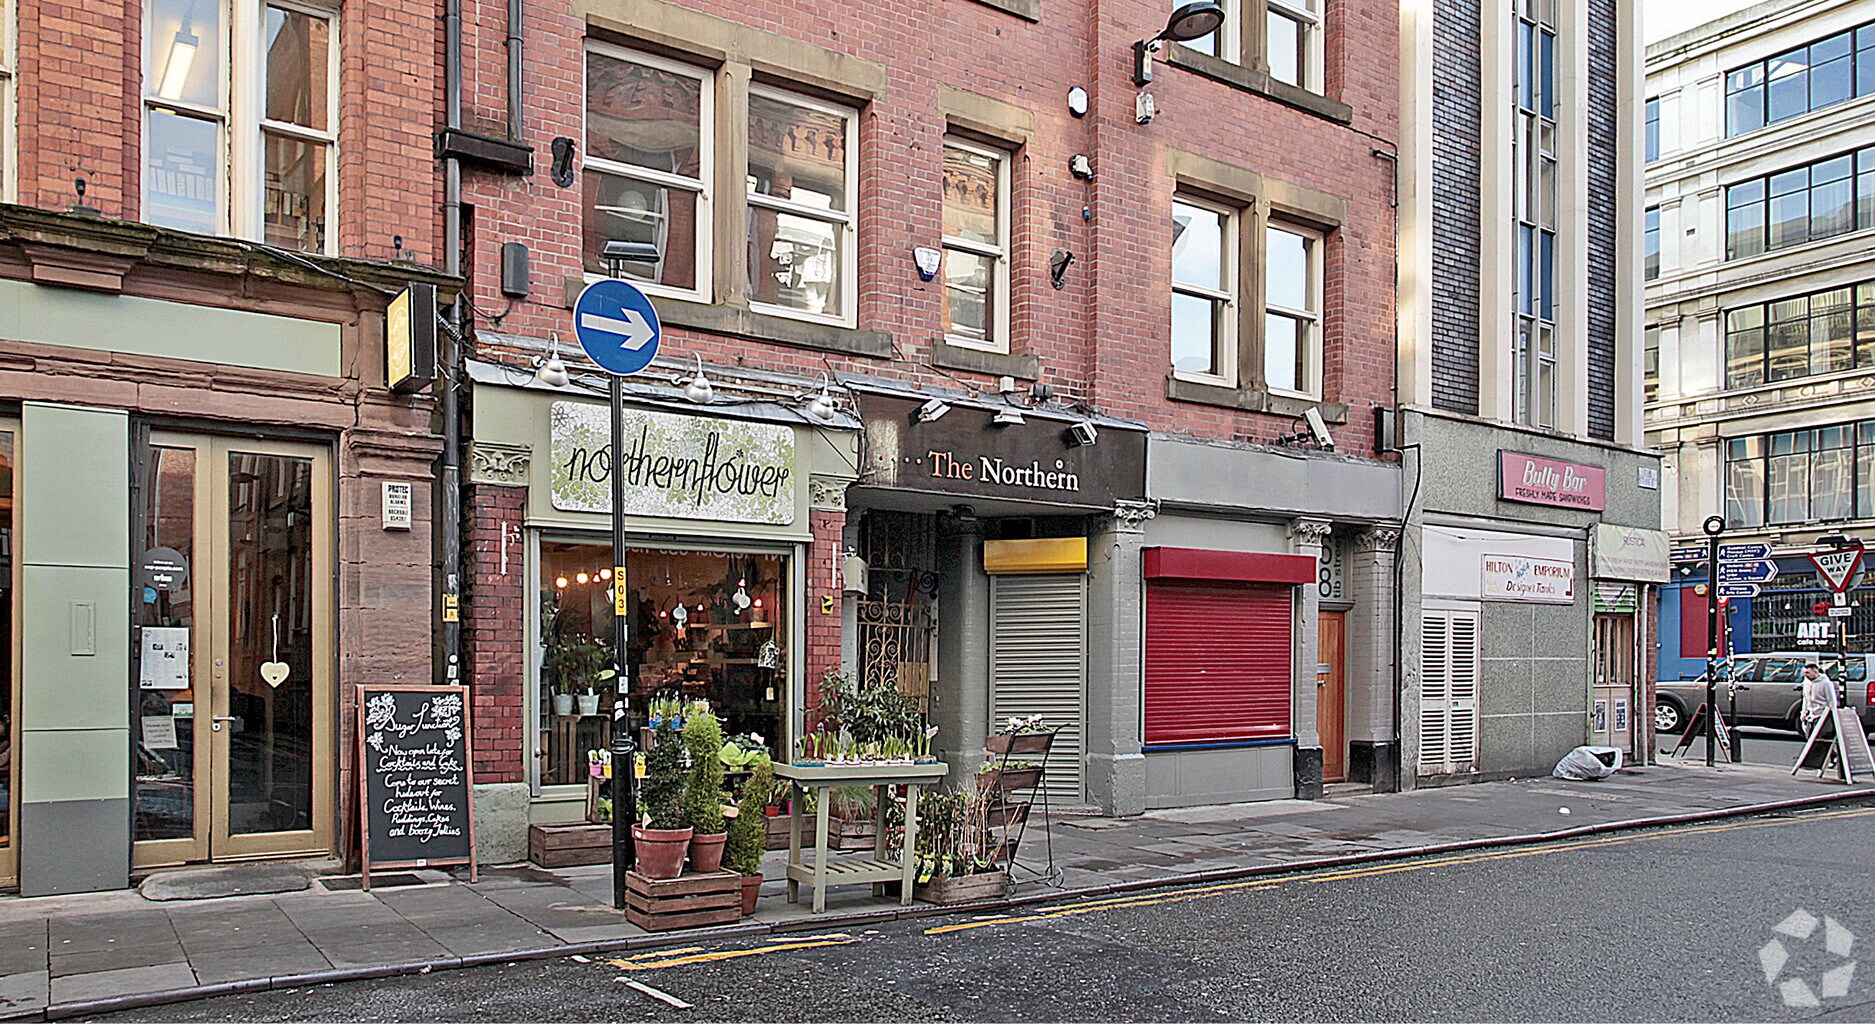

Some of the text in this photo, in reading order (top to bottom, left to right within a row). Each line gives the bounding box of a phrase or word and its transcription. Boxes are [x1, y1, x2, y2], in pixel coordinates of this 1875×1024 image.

[928, 450, 1080, 491] The Northern
[1522, 460, 1588, 493] Butty Bar
[1515, 487, 1591, 506] FRESHLY MADE SANDWICHES
[1333, 535, 1342, 598] tib street
[1820, 553, 1851, 566] GIVE
[1485, 560, 1513, 574] HILTON
[1533, 564, 1570, 578] EMPORIUM
[1827, 565, 1848, 574] WAY
[1506, 580, 1536, 596] Designer
[1536, 582, 1555, 594] Tanks
[1797, 622, 1832, 638] ART
[412, 702, 460, 735] Junction
[388, 742, 454, 759] Now open late for
[379, 755, 459, 773] Cocktails and Cake
[384, 772, 460, 788] Come to our secret
[395, 785, 443, 800] hideout for
[389, 823, 461, 843] and boozy Jellies
